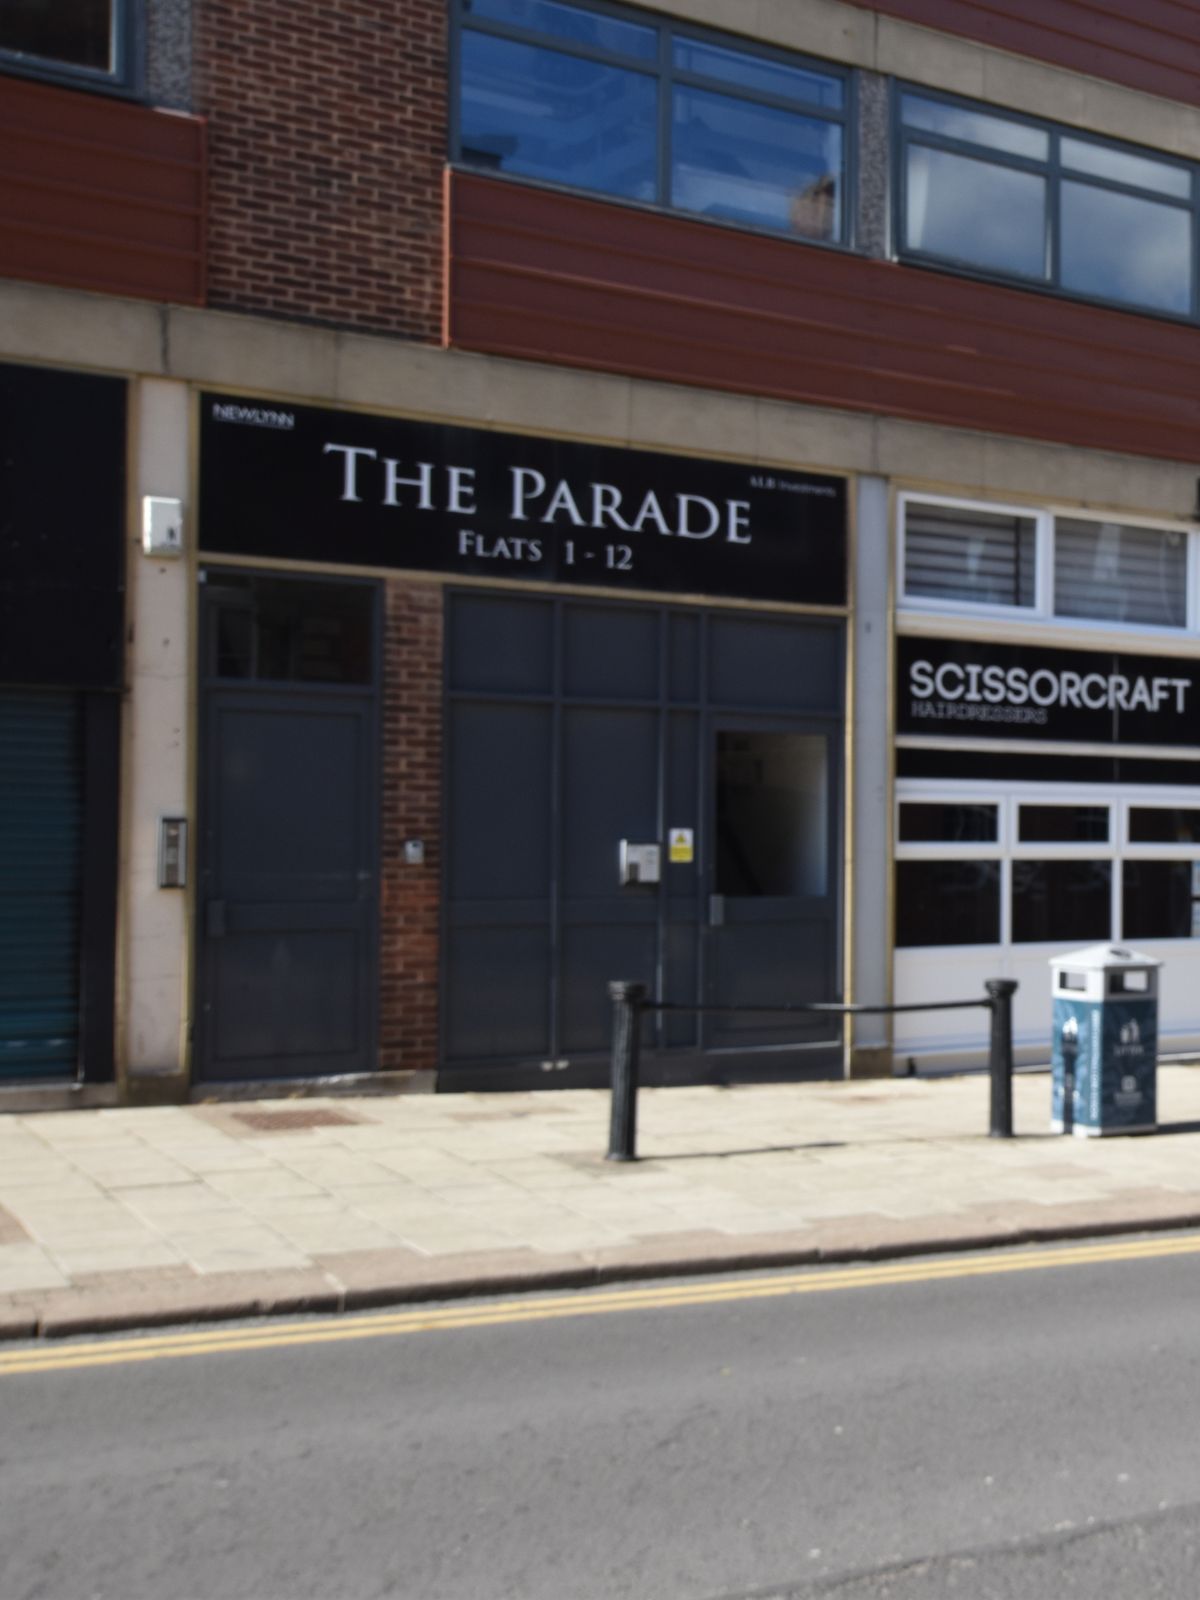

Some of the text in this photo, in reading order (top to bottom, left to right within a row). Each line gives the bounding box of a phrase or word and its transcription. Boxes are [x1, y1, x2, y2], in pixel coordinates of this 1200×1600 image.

[322, 442, 753, 546] THE PARADE
[457, 529, 543, 563] FLATS
[563, 539, 575, 566] 1
[606, 544, 634, 571] 12
[909, 659, 1191, 714] SCISSORCRAFT
